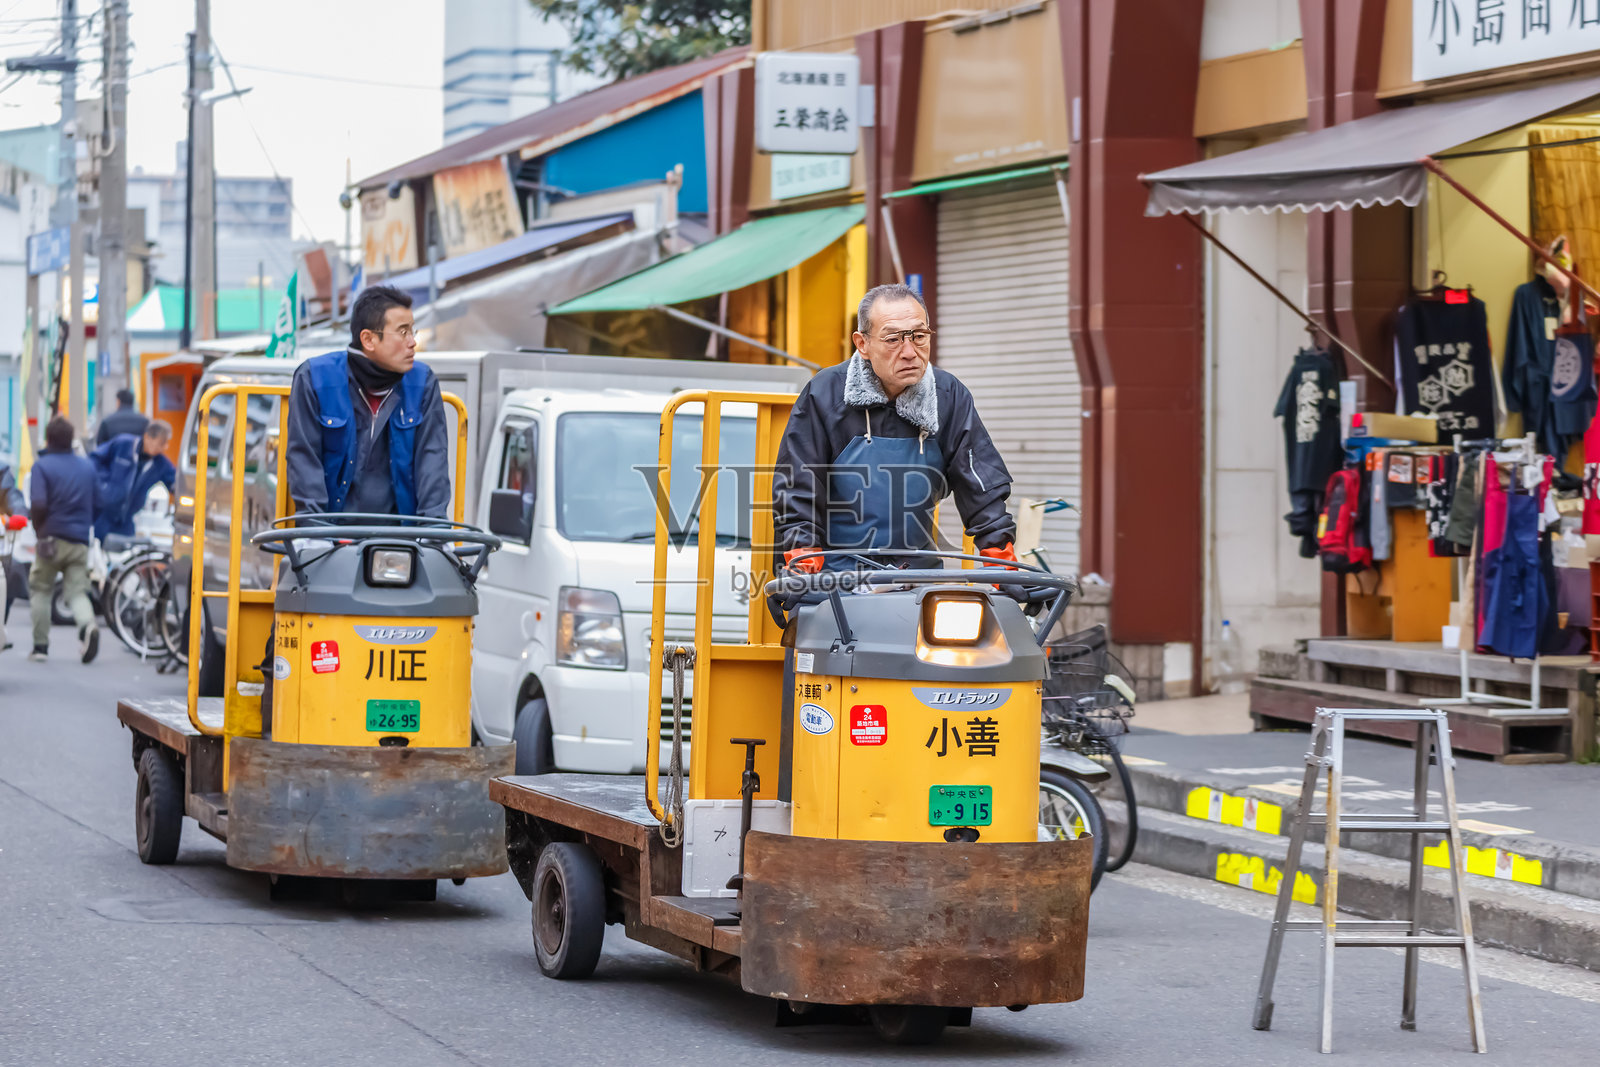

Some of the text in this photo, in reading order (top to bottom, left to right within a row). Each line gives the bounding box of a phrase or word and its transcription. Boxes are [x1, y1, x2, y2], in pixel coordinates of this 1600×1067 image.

[367, 628, 427, 640] エレトラック
[365, 648, 427, 682] 川正
[929, 691, 1001, 705] エレトラック
[925, 716, 1000, 757] 小善
[945, 789, 977, 799] 中央区
[933, 808, 943, 820] ゆ
